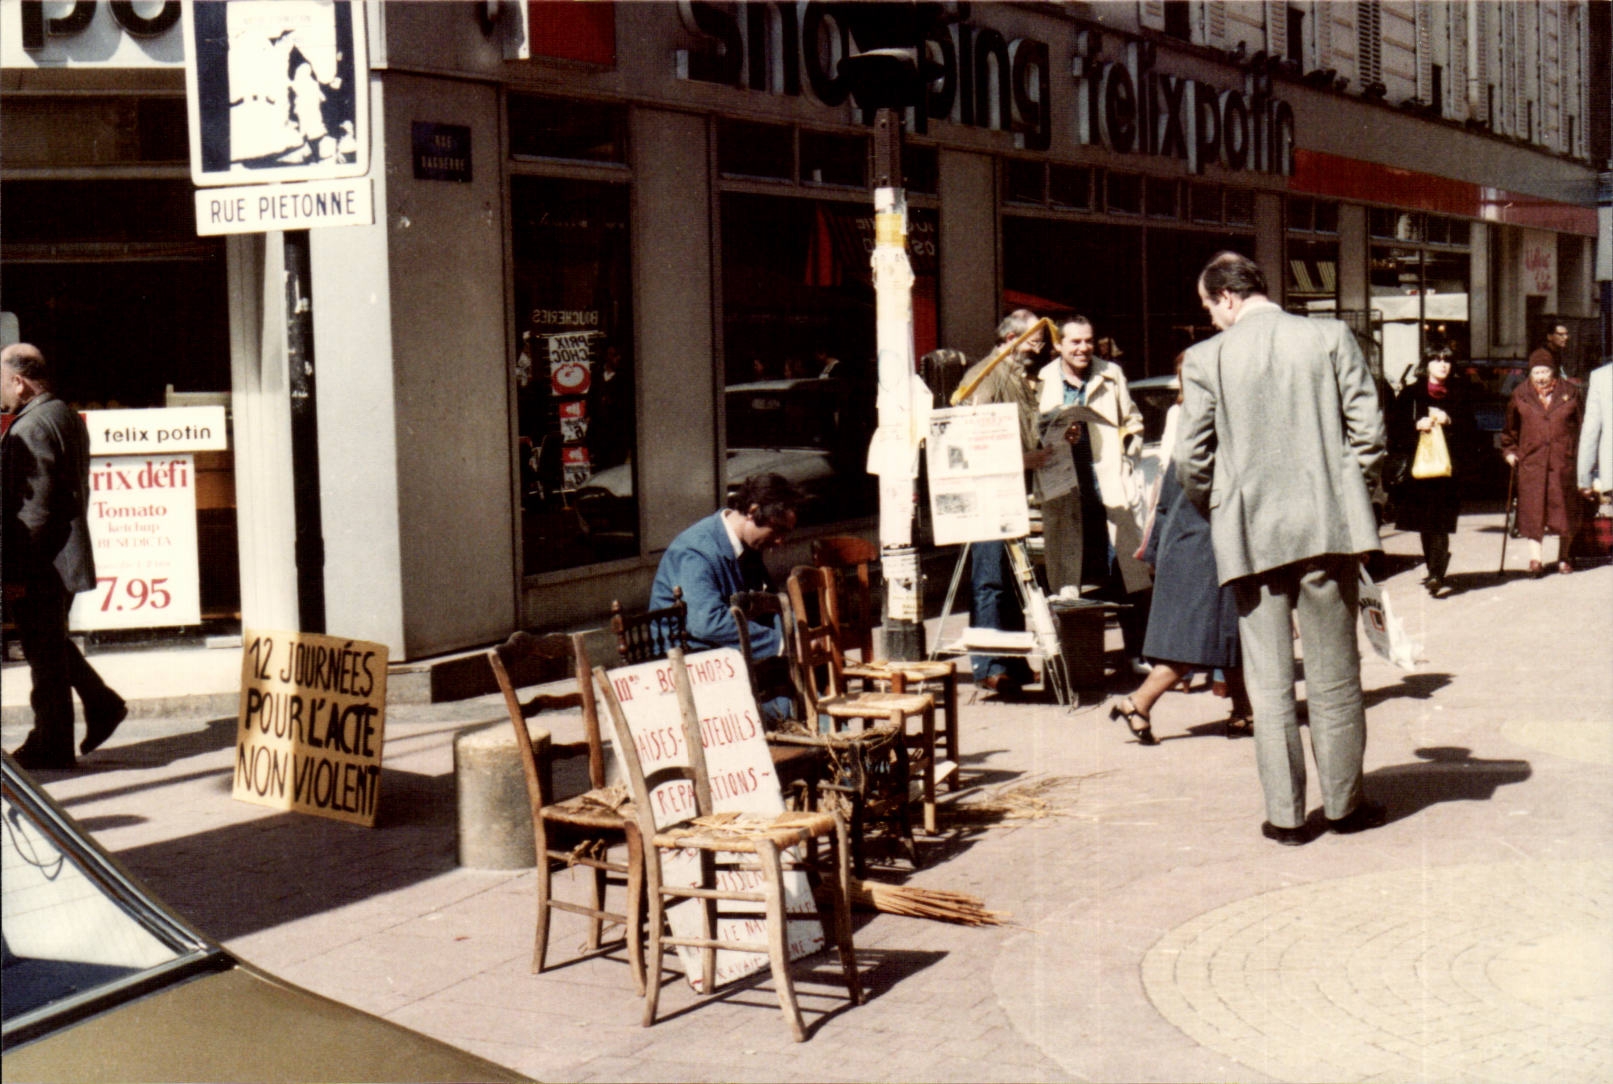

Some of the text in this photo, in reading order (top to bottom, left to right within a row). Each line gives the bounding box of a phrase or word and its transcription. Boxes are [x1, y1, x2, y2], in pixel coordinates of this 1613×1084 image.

[211, 191, 356, 224] RUE PIETONNE
[104, 427, 211, 443] felix potin
[90, 459, 188, 491] rix défi
[93, 501, 167, 519] Tomato
[97, 576, 171, 612] 7.95
[249, 637, 375, 697] 12 JOURNÉES
[245, 688, 378, 757] POUR L'ACTE
[238, 742, 380, 816] NON VIOLENT
